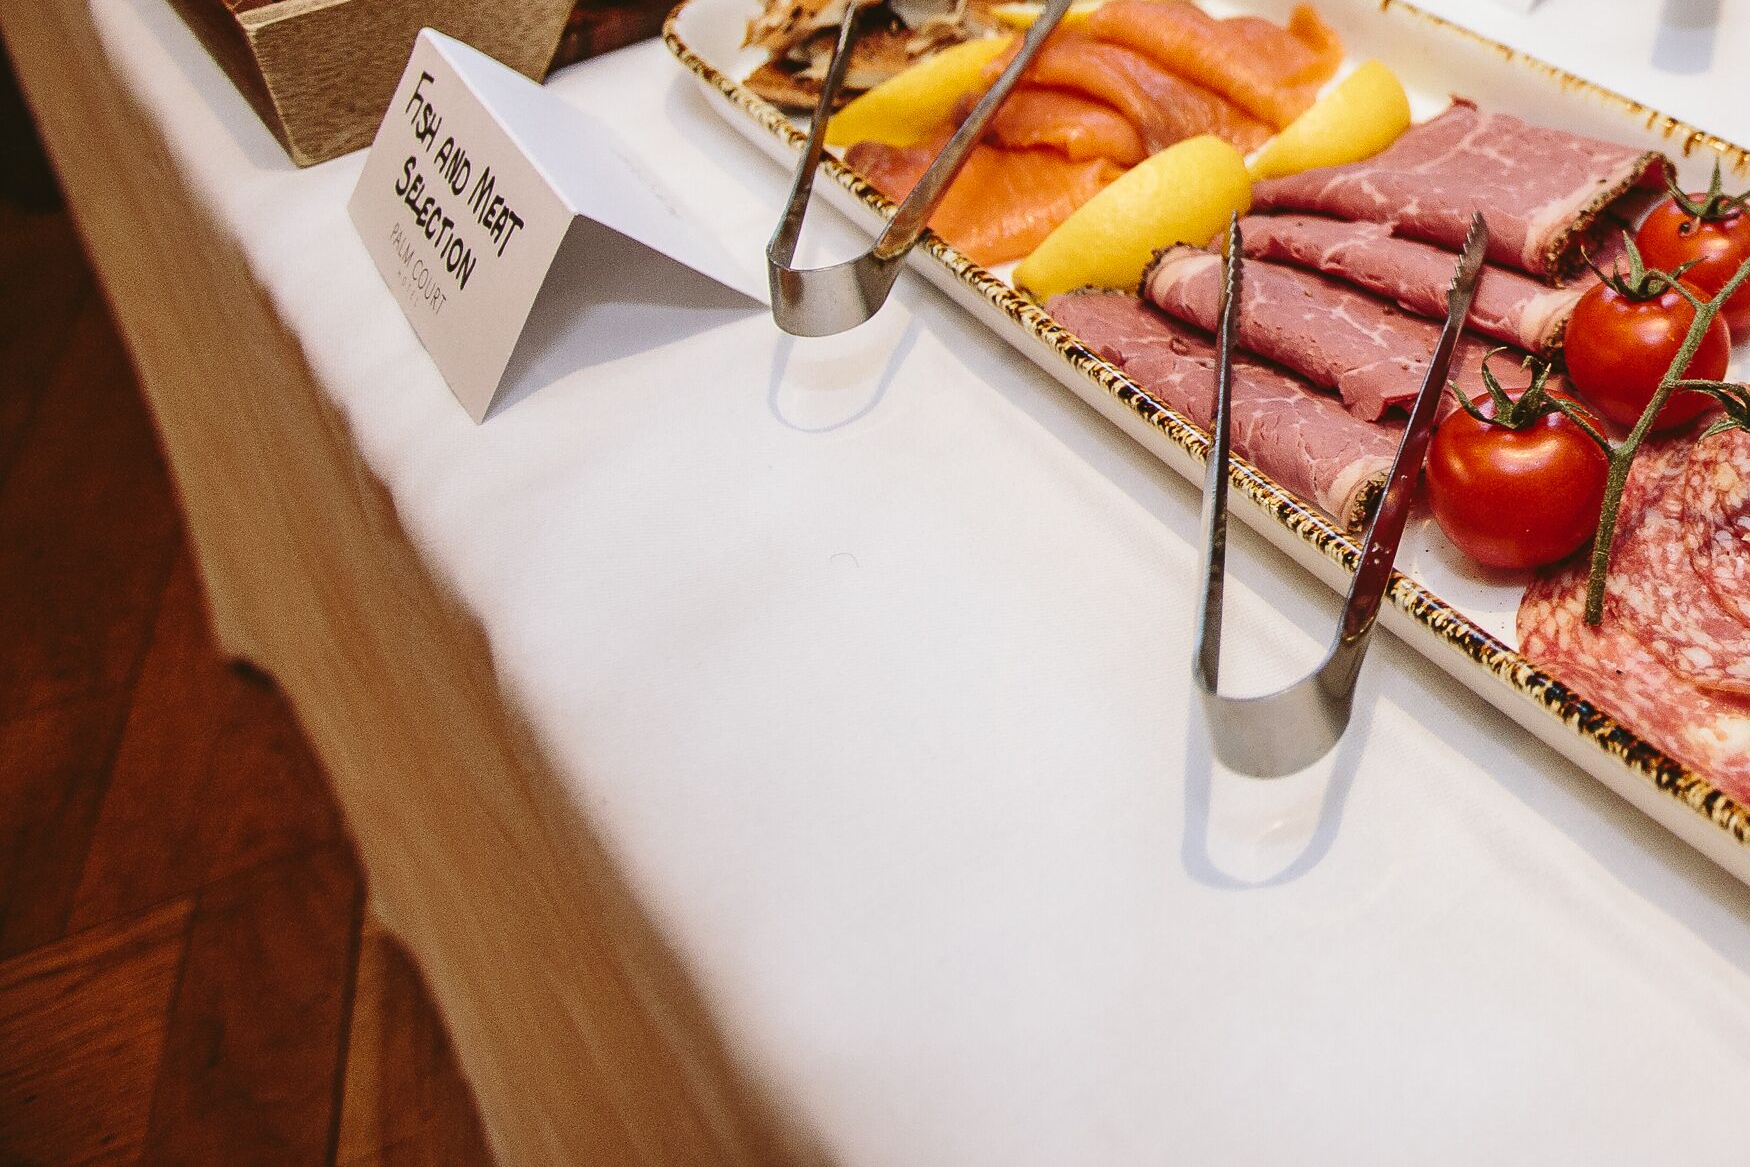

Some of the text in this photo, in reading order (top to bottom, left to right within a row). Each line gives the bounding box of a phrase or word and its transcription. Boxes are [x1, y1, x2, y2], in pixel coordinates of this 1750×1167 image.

[395, 155, 477, 291] SELECTION
[404, 71, 525, 258] FISH AND MEAT
[390, 221, 447, 315] PALM COURT
